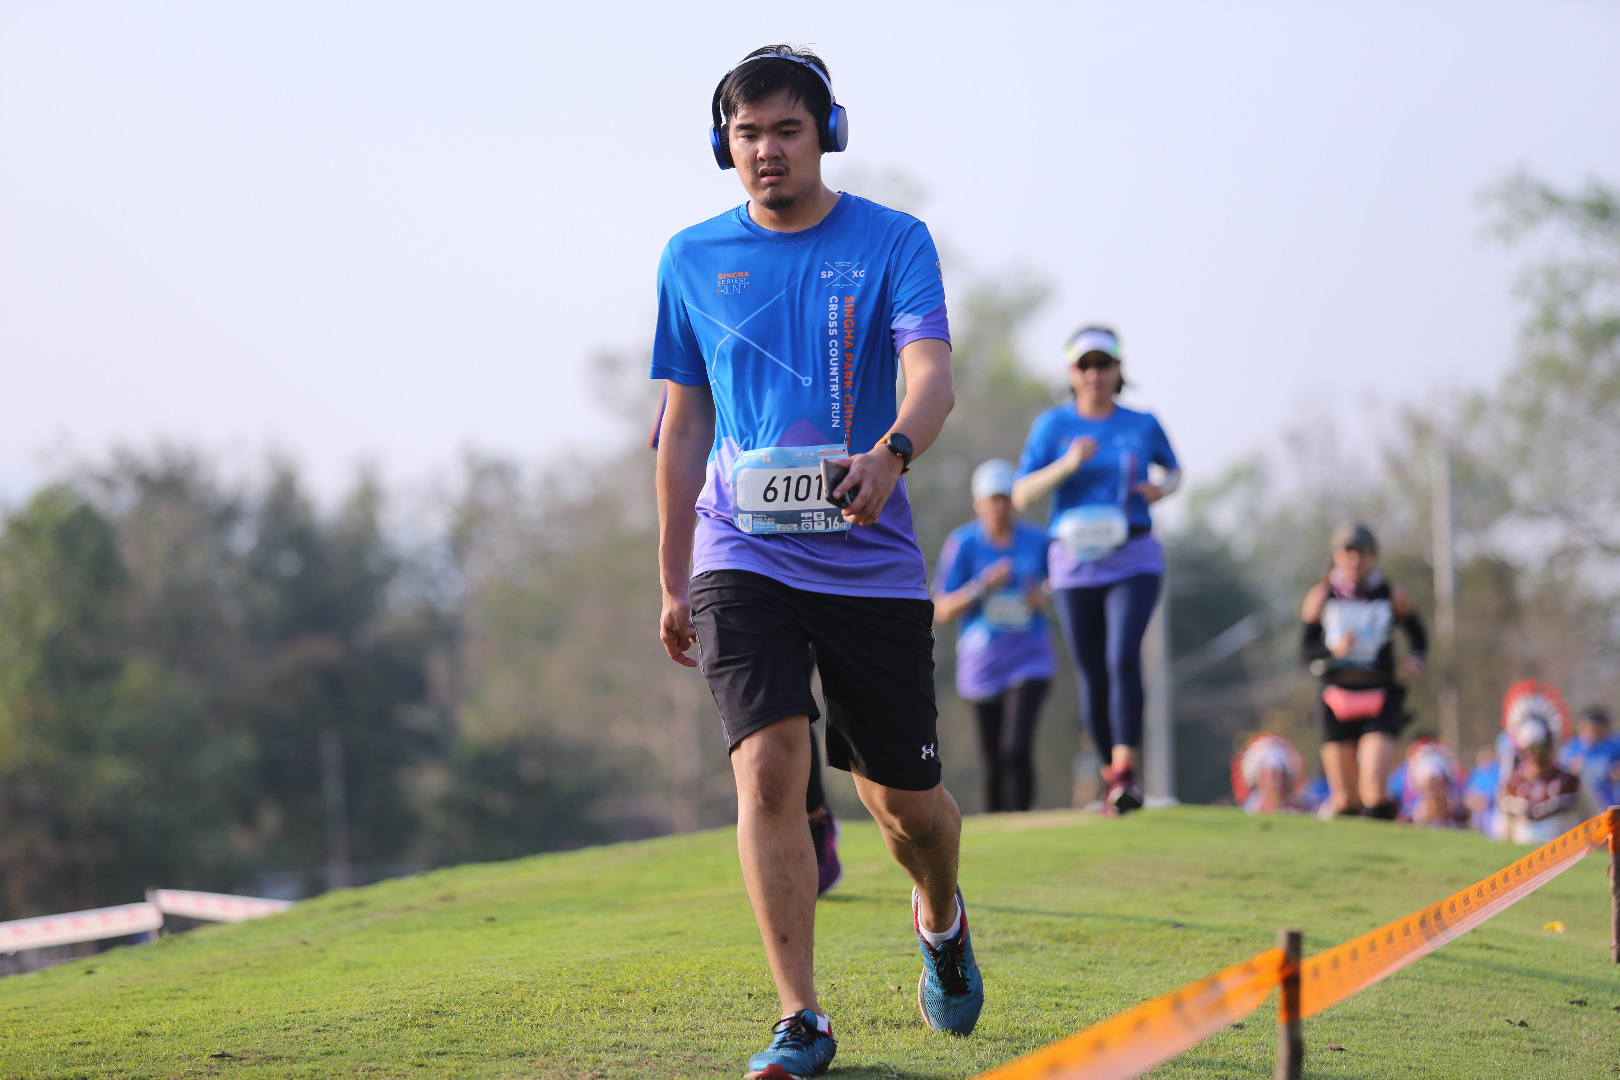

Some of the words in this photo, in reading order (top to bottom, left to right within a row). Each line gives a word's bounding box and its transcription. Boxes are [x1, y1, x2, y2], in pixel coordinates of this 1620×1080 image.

[717, 271, 750, 280] SINGHA
[820, 270, 834, 279] SP
[852, 269, 865, 278] XC
[829, 296, 839, 336] CROSS
[843, 296, 855, 349] SINGHA
[829, 340, 840, 399] COUNTRY
[843, 353, 853, 390] PARK
[831, 403, 840, 428] RUN
[762, 474, 823, 503] 6101
